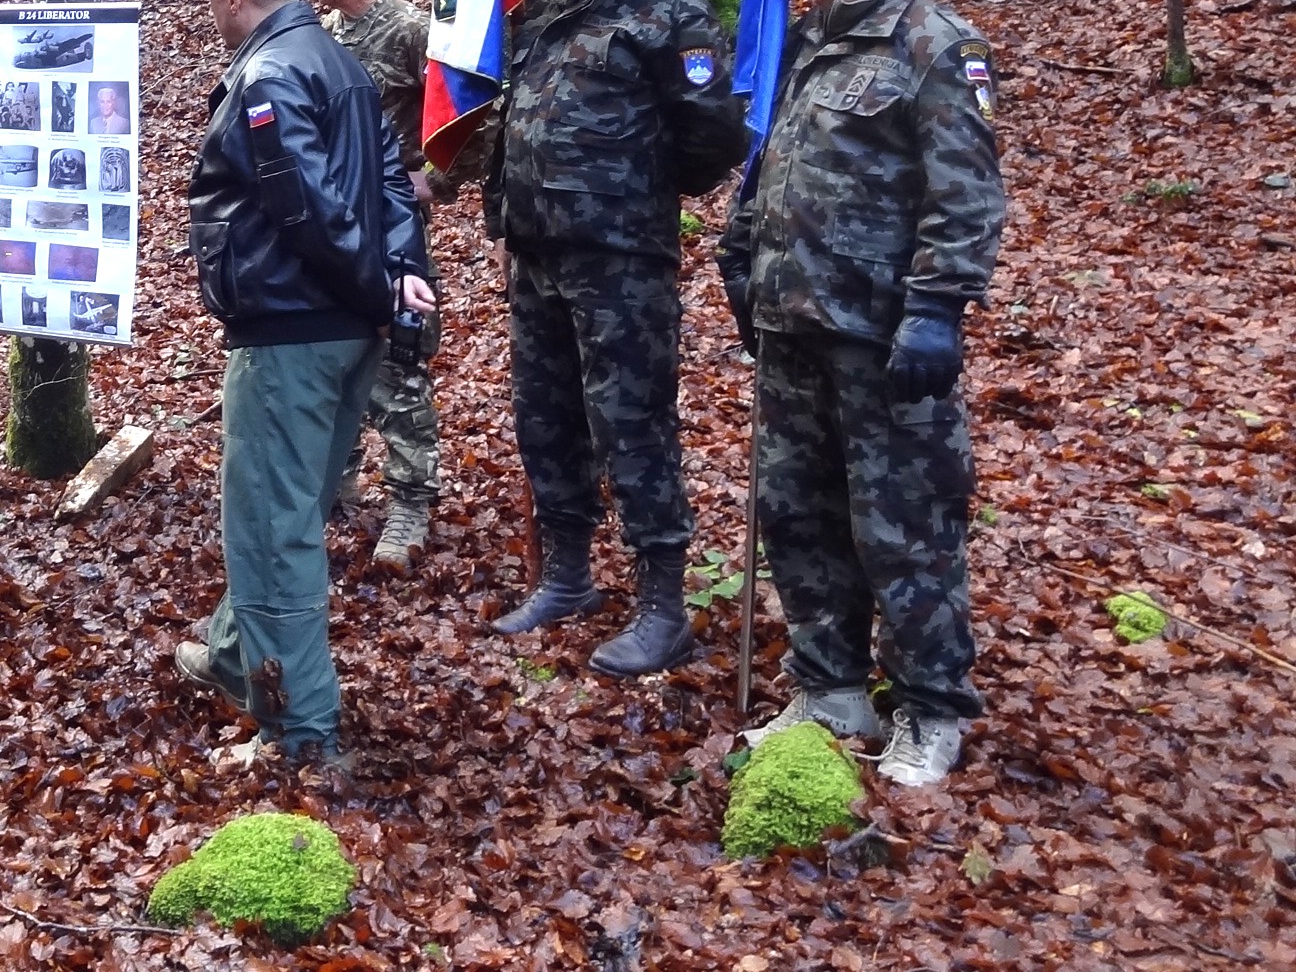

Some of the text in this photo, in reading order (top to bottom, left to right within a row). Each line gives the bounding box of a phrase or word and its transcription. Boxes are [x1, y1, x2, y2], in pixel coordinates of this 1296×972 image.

[18, 10, 90, 20] B 24 LIBERATOR
